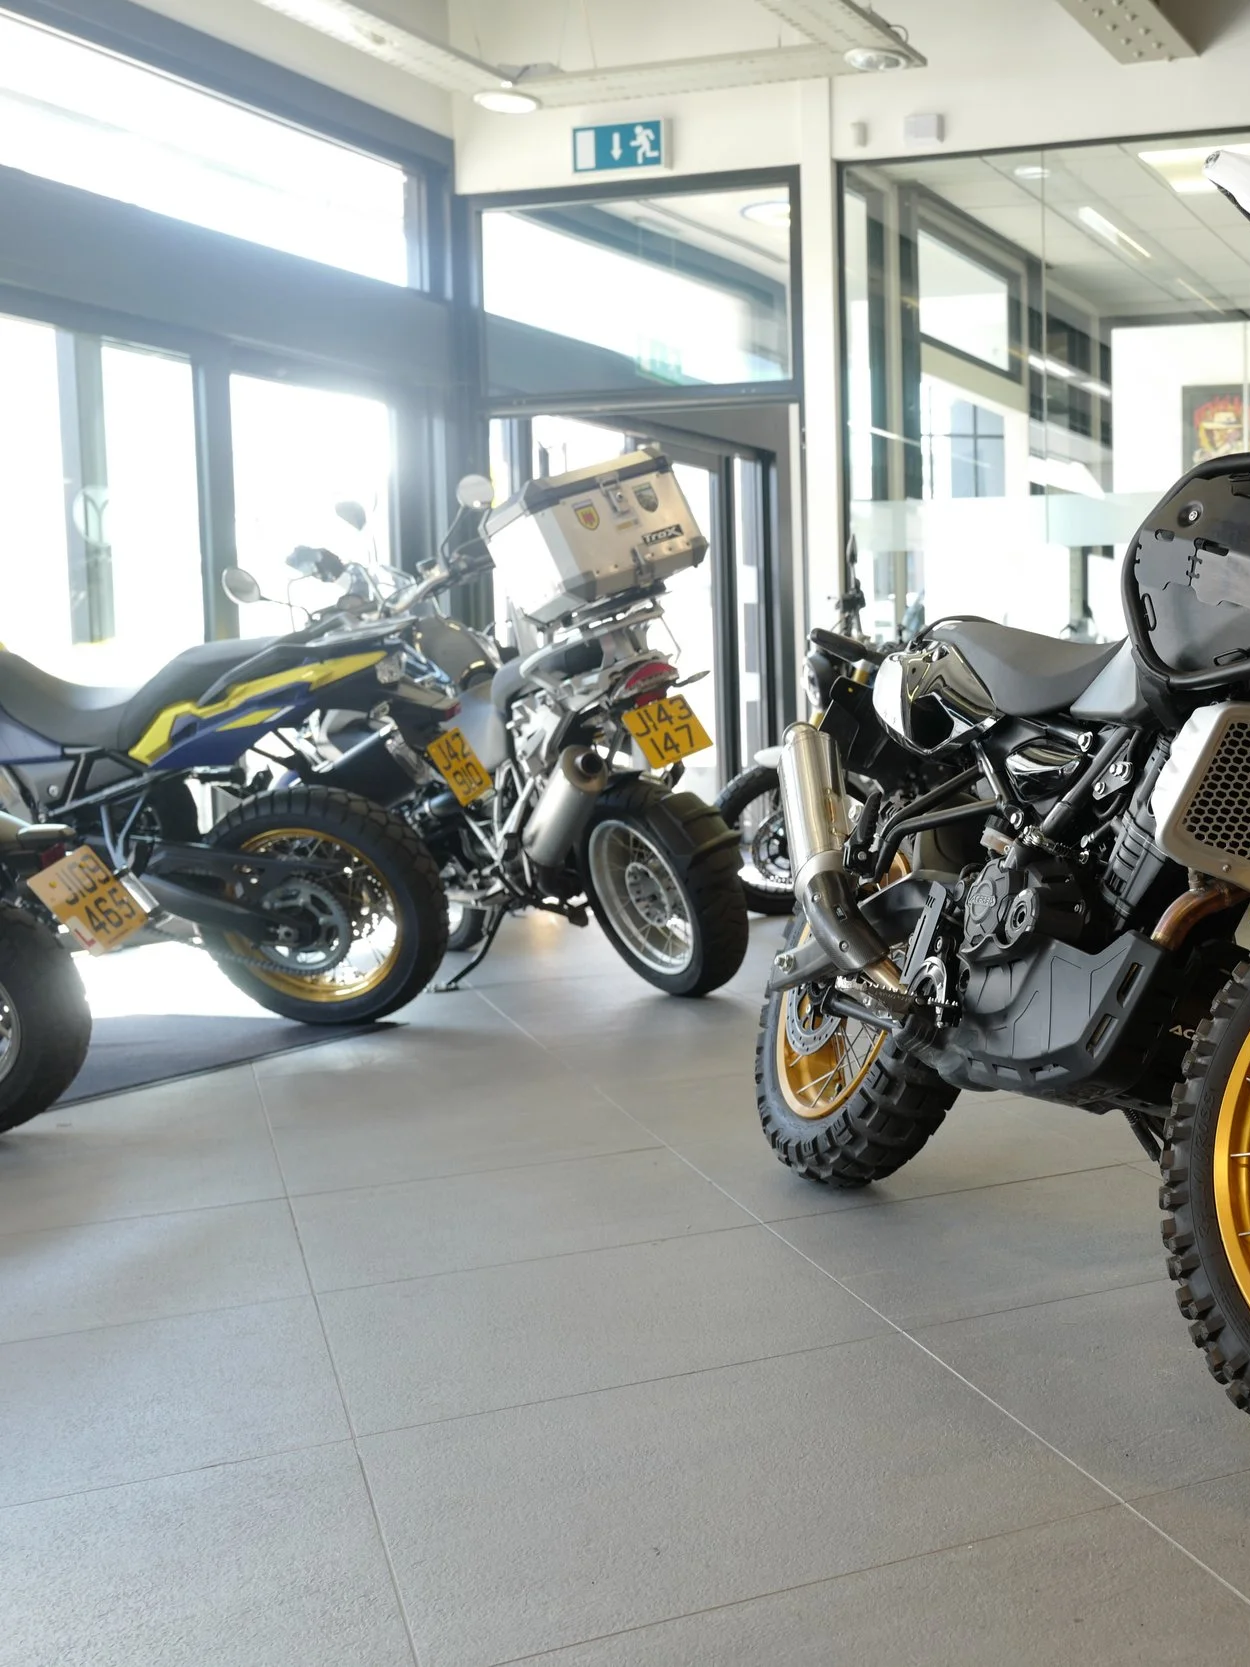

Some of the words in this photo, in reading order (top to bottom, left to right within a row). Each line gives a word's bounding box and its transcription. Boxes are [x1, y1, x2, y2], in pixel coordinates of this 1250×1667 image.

[635, 697, 693, 737] J143
[650, 723, 695, 760] 147
[84, 887, 136, 934] 465
[74, 928, 97, 948] L
